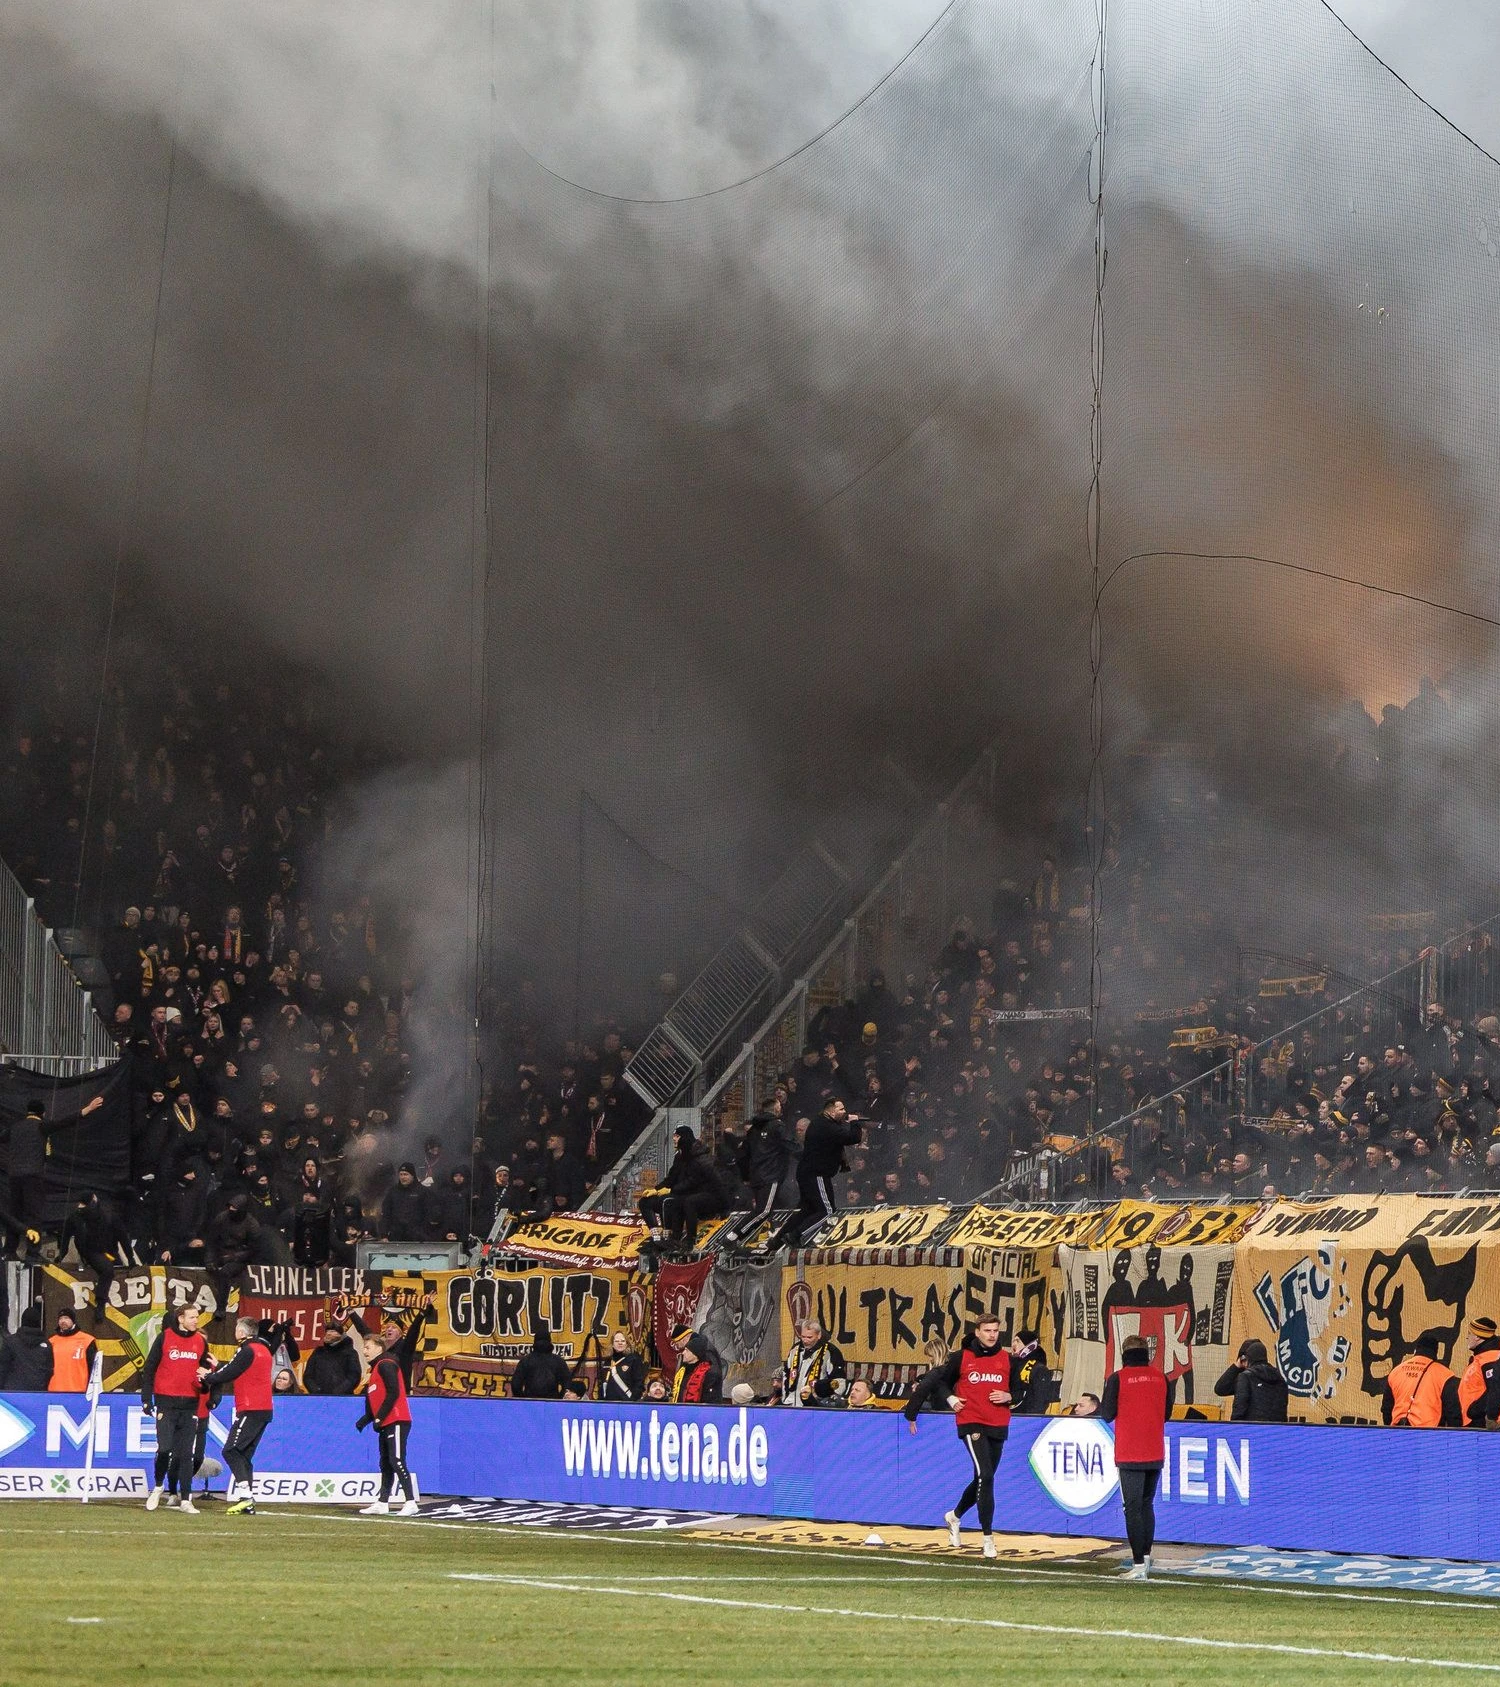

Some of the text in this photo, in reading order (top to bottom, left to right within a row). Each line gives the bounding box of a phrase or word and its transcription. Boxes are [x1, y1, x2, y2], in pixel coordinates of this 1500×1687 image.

[518, 1222, 619, 1249] BRIGADE
[1256, 1206, 1379, 1237] DYNAMO
[972, 1244, 1041, 1279] OFFICIAL
[247, 1264, 371, 1297] SCHNELLER
[448, 1268, 612, 1338] GÖRLITZ
[817, 1282, 963, 1351] ULTRAS
[980, 1373, 1003, 1383] JAKO
[562, 1408, 769, 1486] www.tena.de
[1048, 1441, 1104, 1478] TENA
[77, 1475, 144, 1493] GRAF
